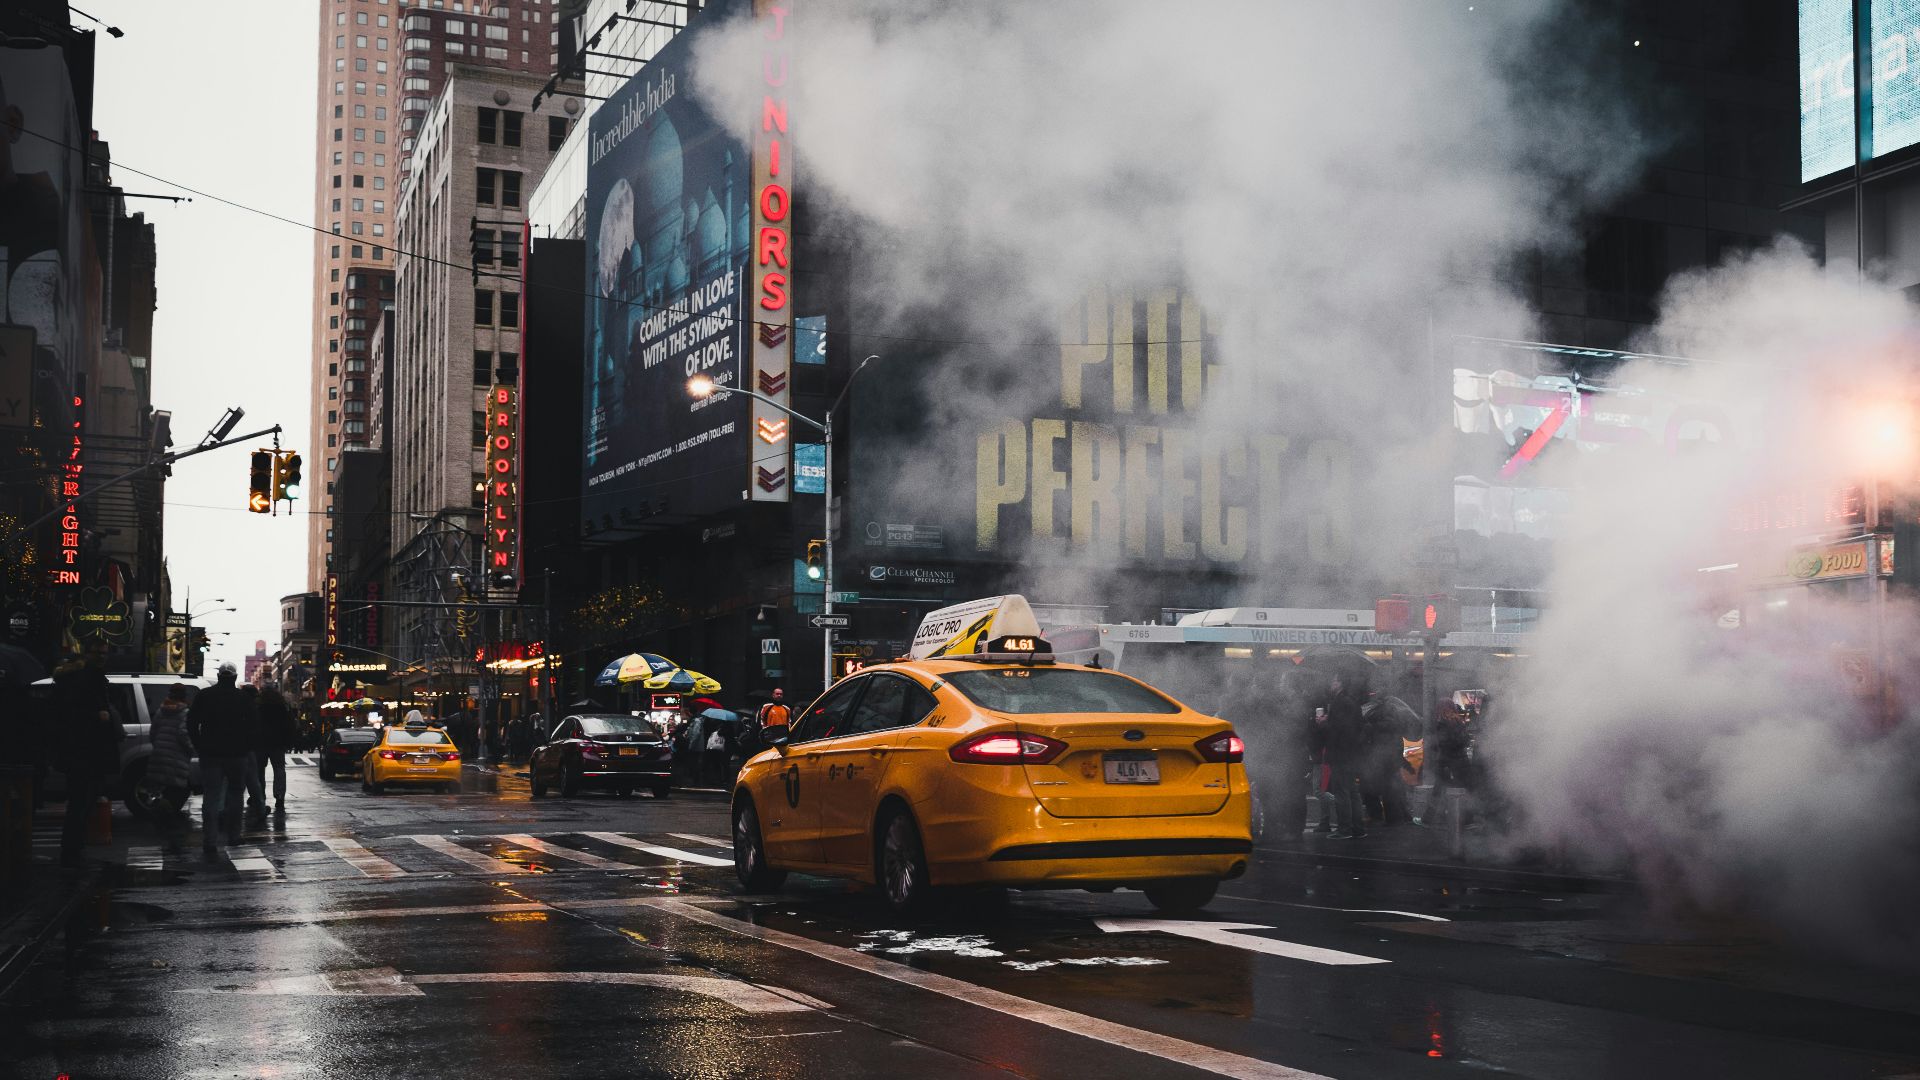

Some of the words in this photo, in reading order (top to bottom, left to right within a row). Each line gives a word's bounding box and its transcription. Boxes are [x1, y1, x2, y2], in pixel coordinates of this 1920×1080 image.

[591, 92, 646, 167] Incredible
[639, 309, 667, 344] COME
[668, 297, 690, 329] FALL
[691, 288, 704, 314] IN
[706, 270, 734, 306] LOVE
[643, 340, 667, 370] WITH
[669, 328, 687, 356] THE
[688, 303, 734, 347] SYMBOL
[685, 350, 700, 377] OF
[702, 335, 734, 370] LOVE.
[496, 390, 511, 567] BROOKLYN
[616, 465, 625, 476] NEW
[625, 462, 636, 473] YORK
[975, 416, 1288, 563] PERFECT
[1824, 550, 1863, 572] FOOD
[832, 617, 846, 625] WAY
[916, 622, 942, 639] LOGIC
[943, 619, 962, 634] PRO
[1004, 638, 1036, 652] 4L61
[1129, 630, 1151, 639] 6765
[1250, 630, 1308, 643] WINNER
[1310, 631, 1318, 643] 6
[1320, 631, 1358, 645] TONY
[328, 663, 387, 672] AMBASSADOR
